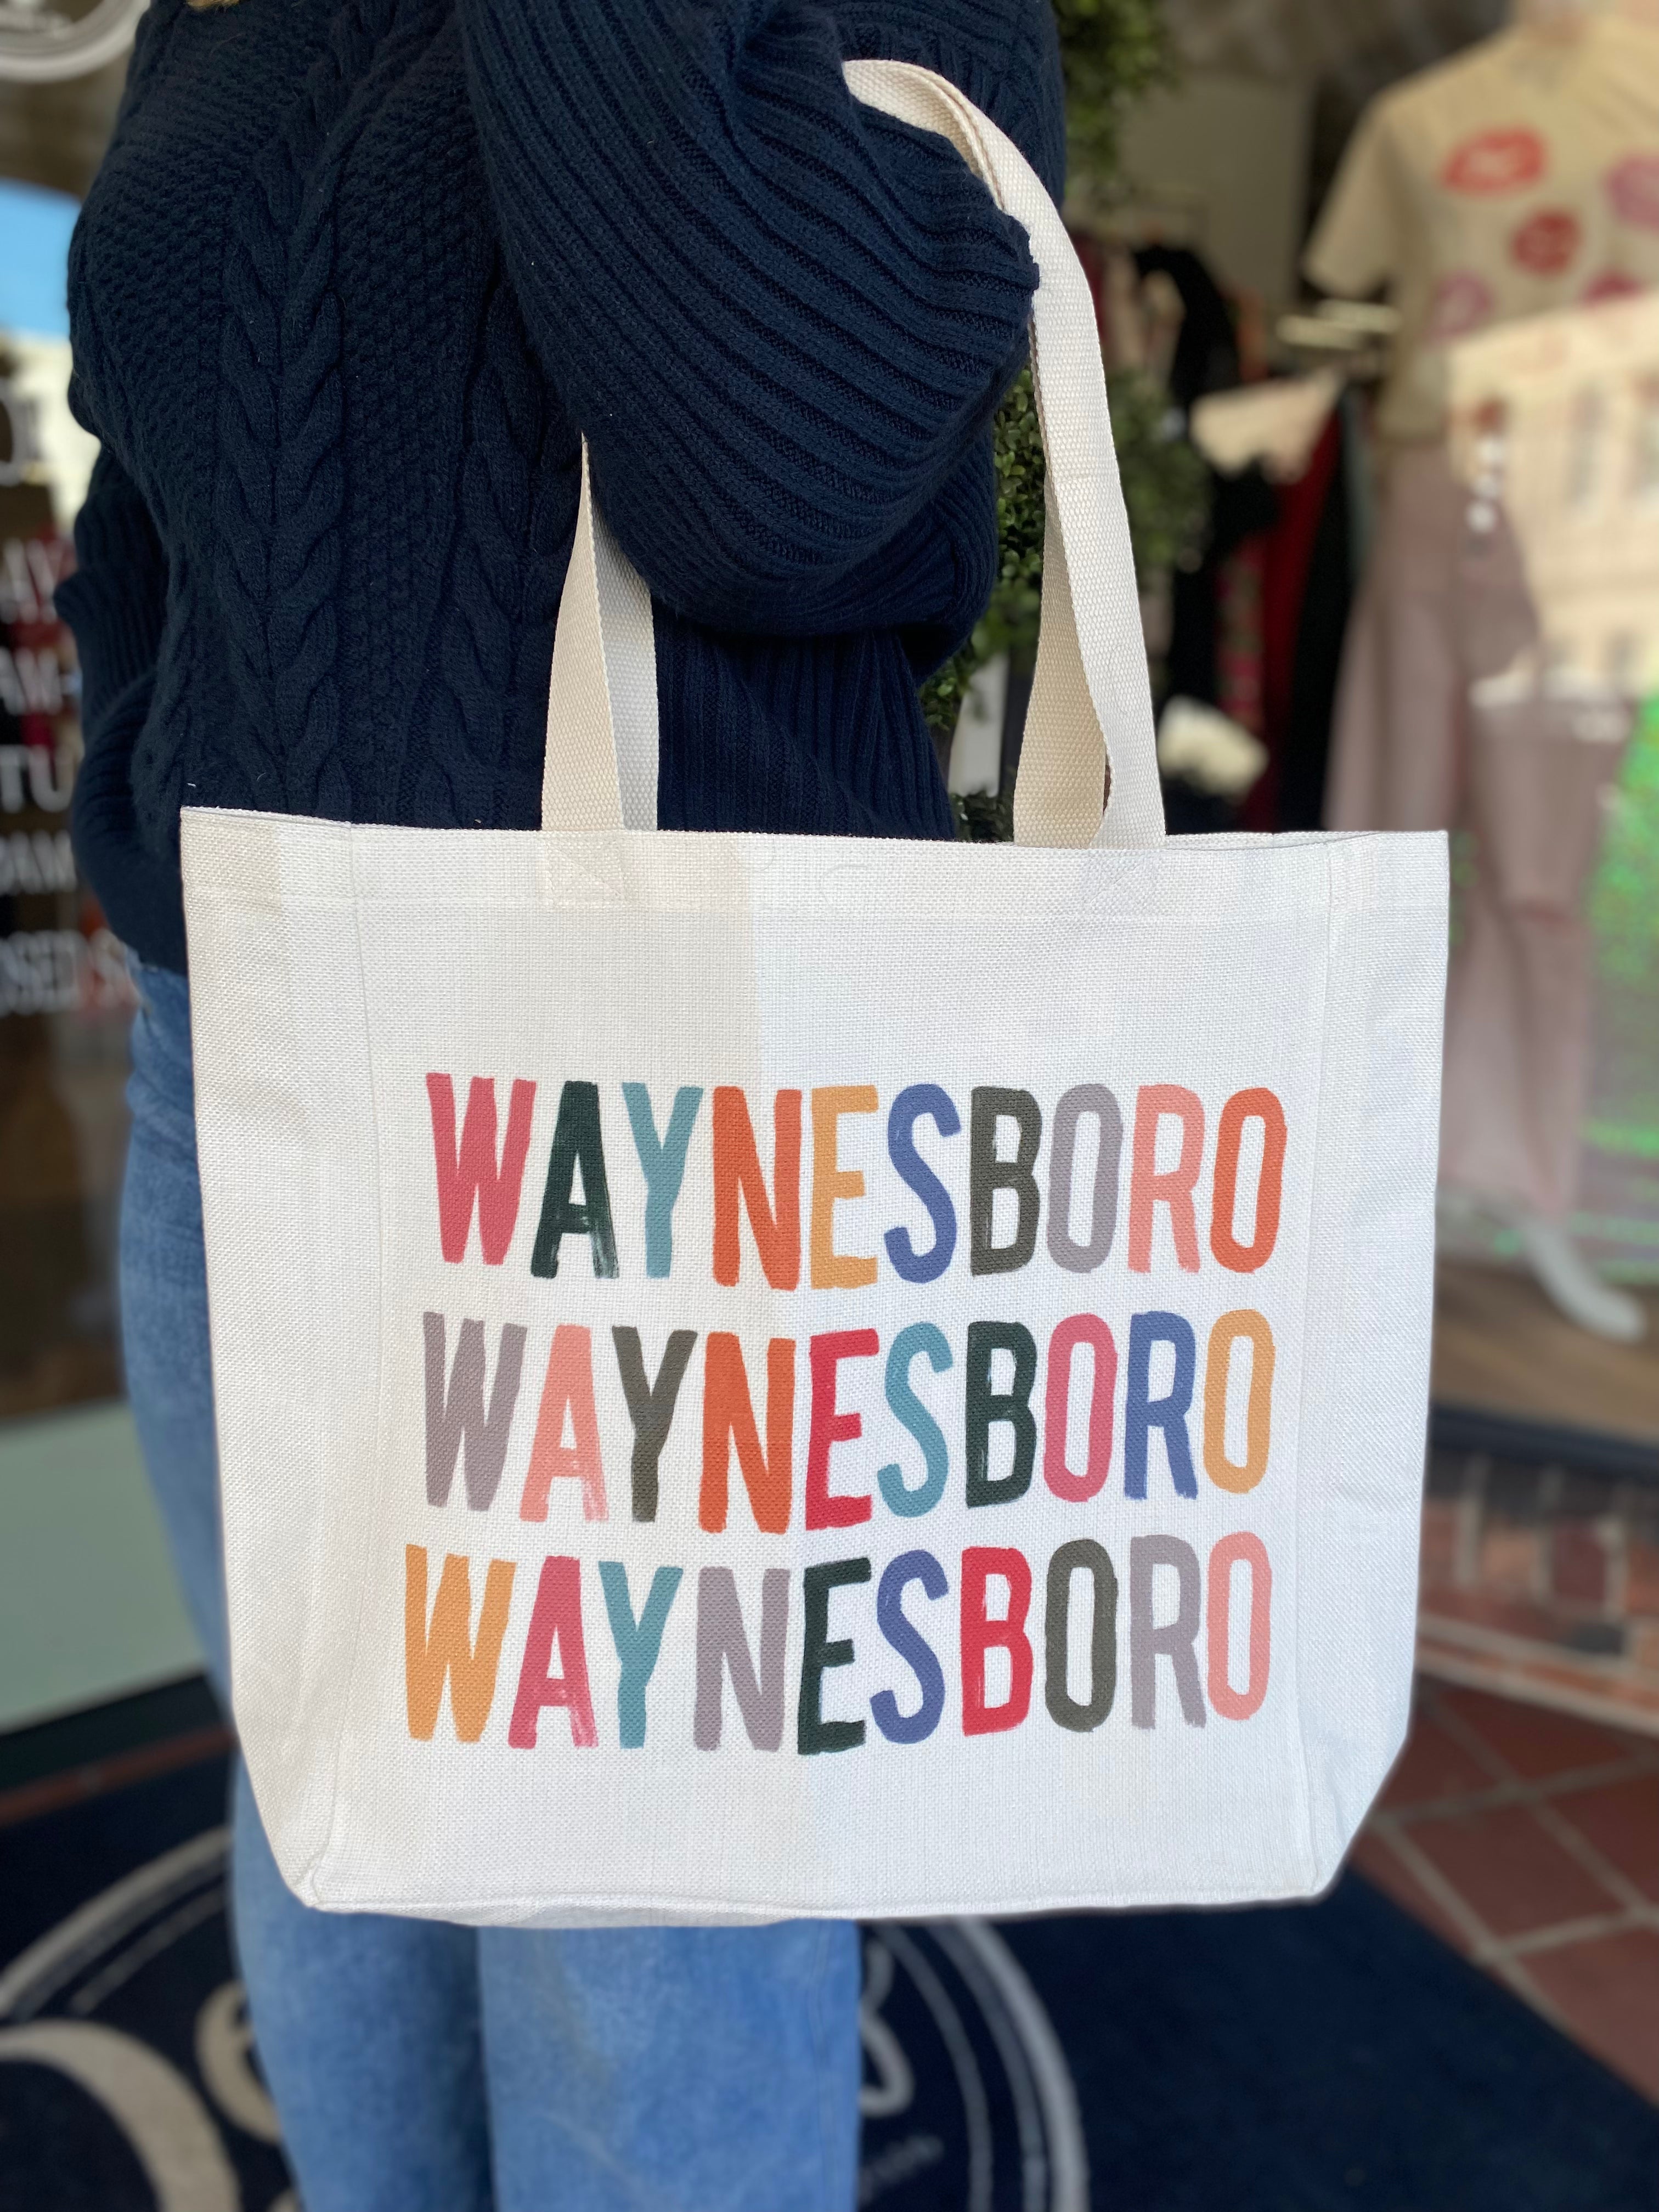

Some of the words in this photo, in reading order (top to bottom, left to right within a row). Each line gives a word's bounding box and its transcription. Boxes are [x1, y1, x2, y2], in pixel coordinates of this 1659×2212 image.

[425, 1072, 1288, 1292] WAYNESBORO
[421, 1309, 1276, 1535] WAYNESBORO
[405, 1532, 1273, 1756] WAYNESBORO
